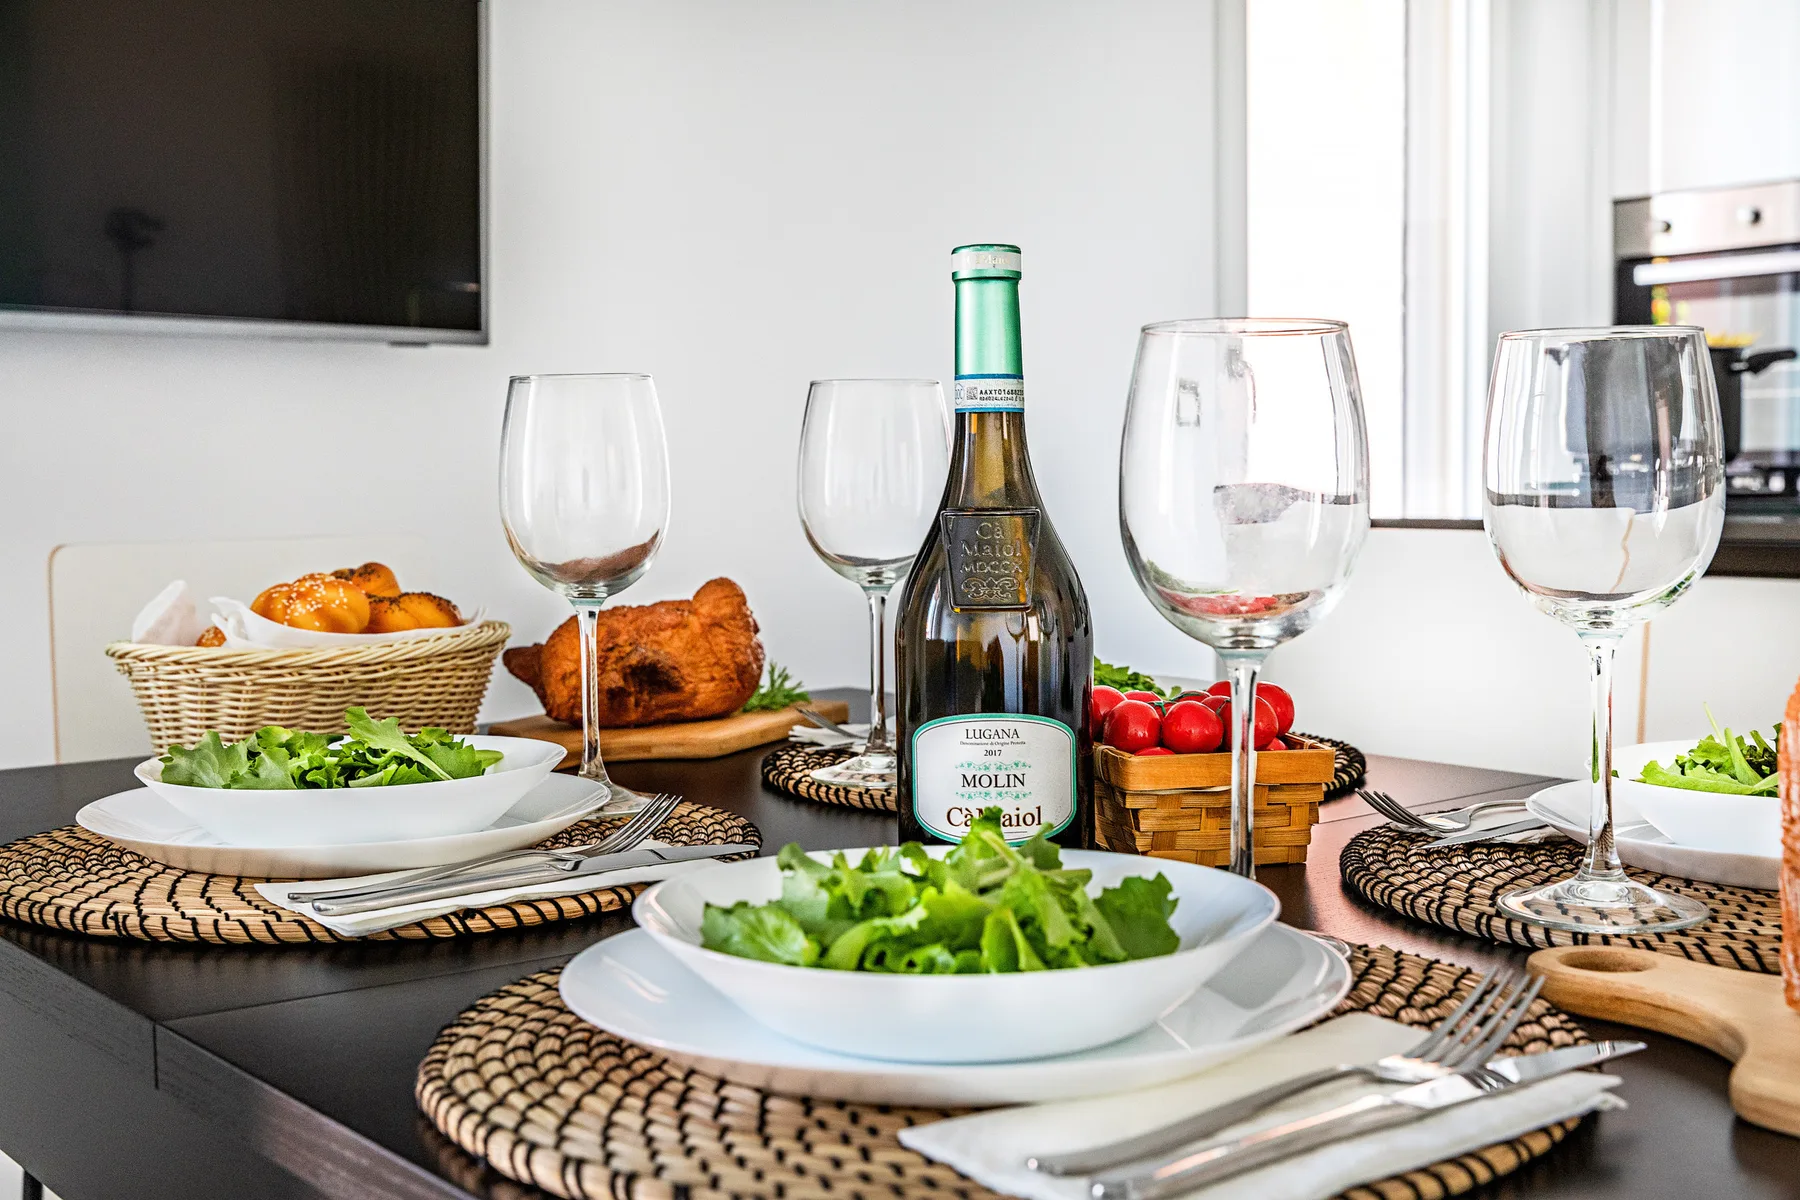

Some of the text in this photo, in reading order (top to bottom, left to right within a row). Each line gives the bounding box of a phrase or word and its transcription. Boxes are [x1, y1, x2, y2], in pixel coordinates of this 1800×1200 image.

[960, 538, 1022, 557] Maiol
[965, 728, 1020, 740] LUGANA
[983, 749, 1002, 757] 2017
[961, 773, 1026, 788] MOLIN
